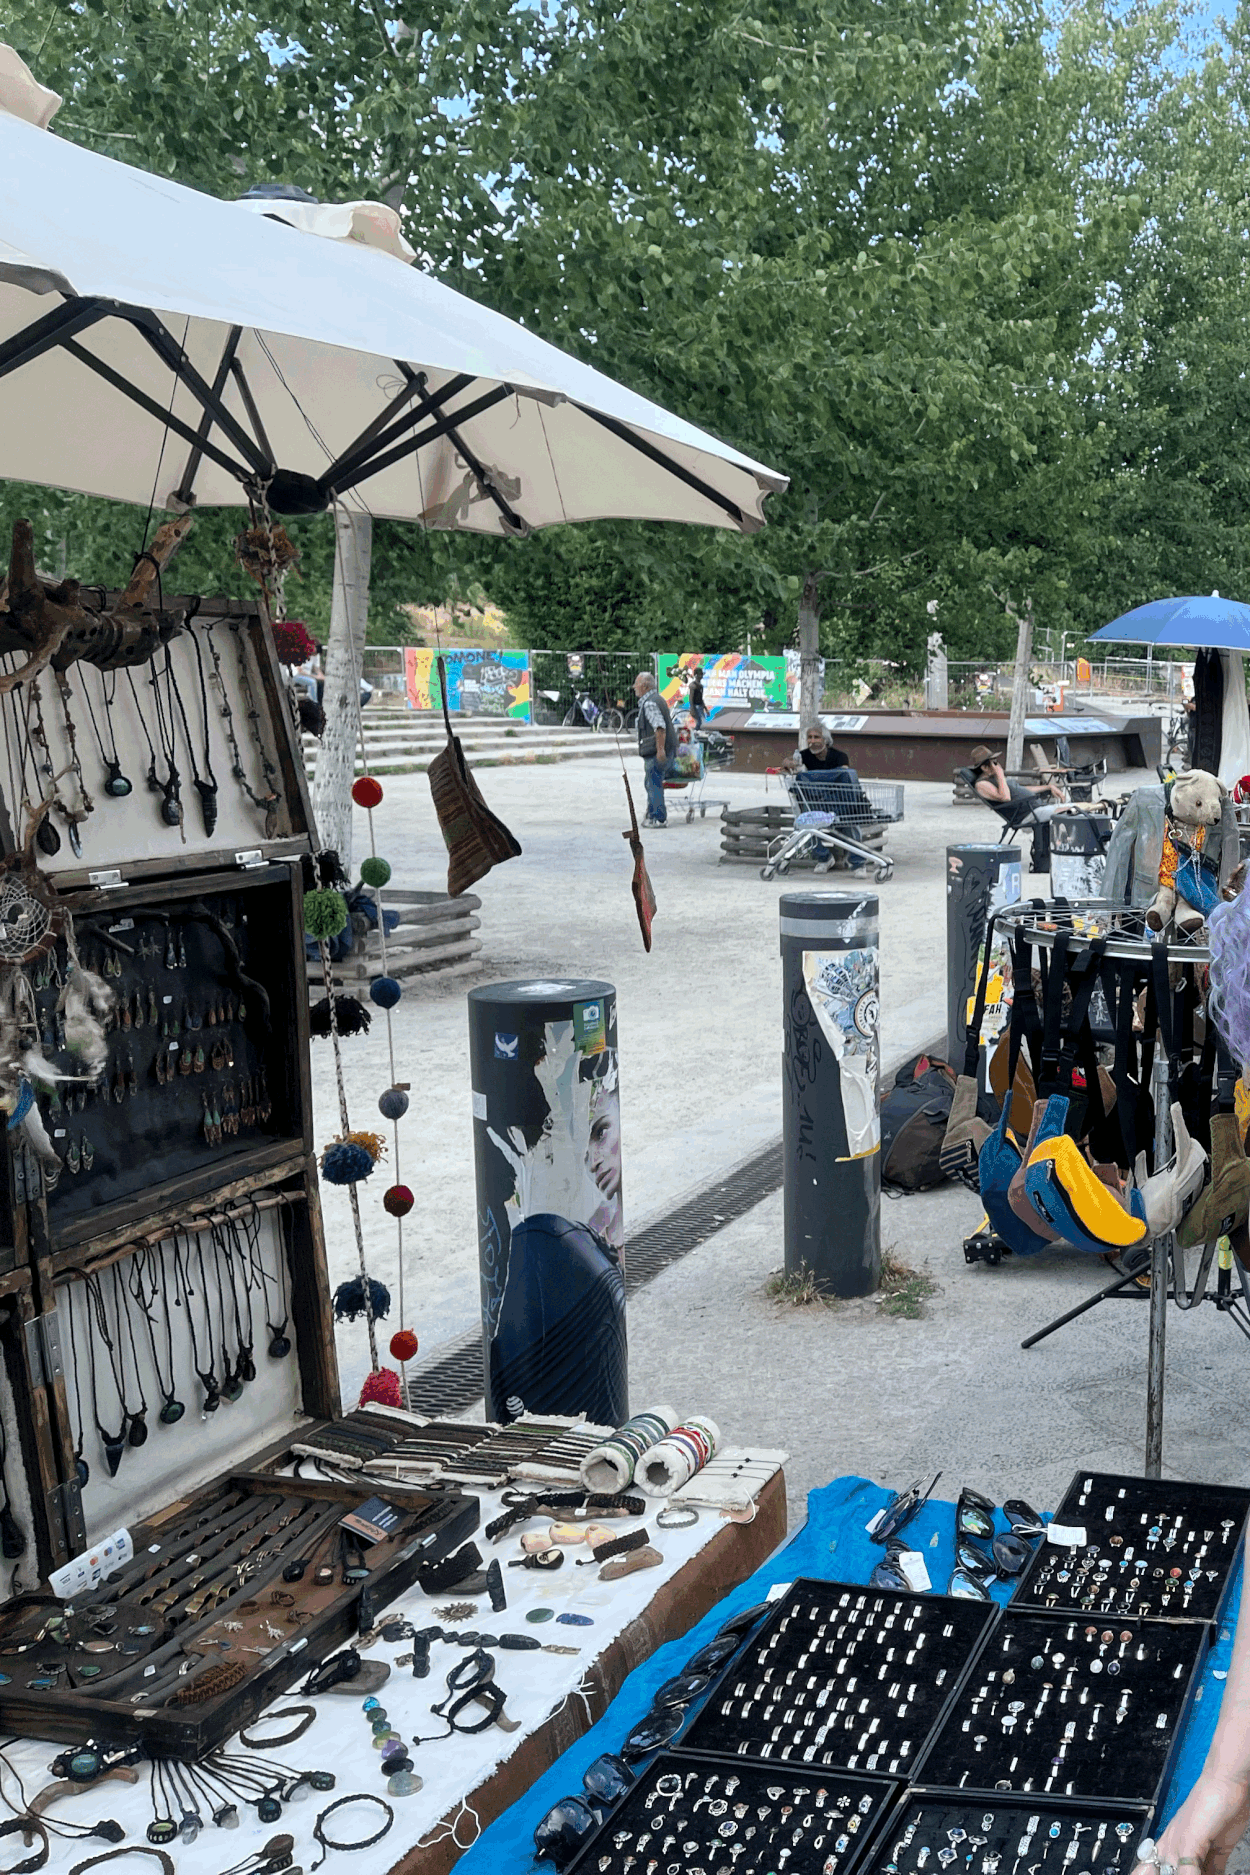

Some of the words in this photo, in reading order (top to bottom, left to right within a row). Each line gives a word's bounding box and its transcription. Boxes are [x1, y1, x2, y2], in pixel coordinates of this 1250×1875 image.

[738, 670, 775, 680] OLYMPIA
[728, 679, 763, 688] MACHEN
[728, 688, 748, 697] HALT
